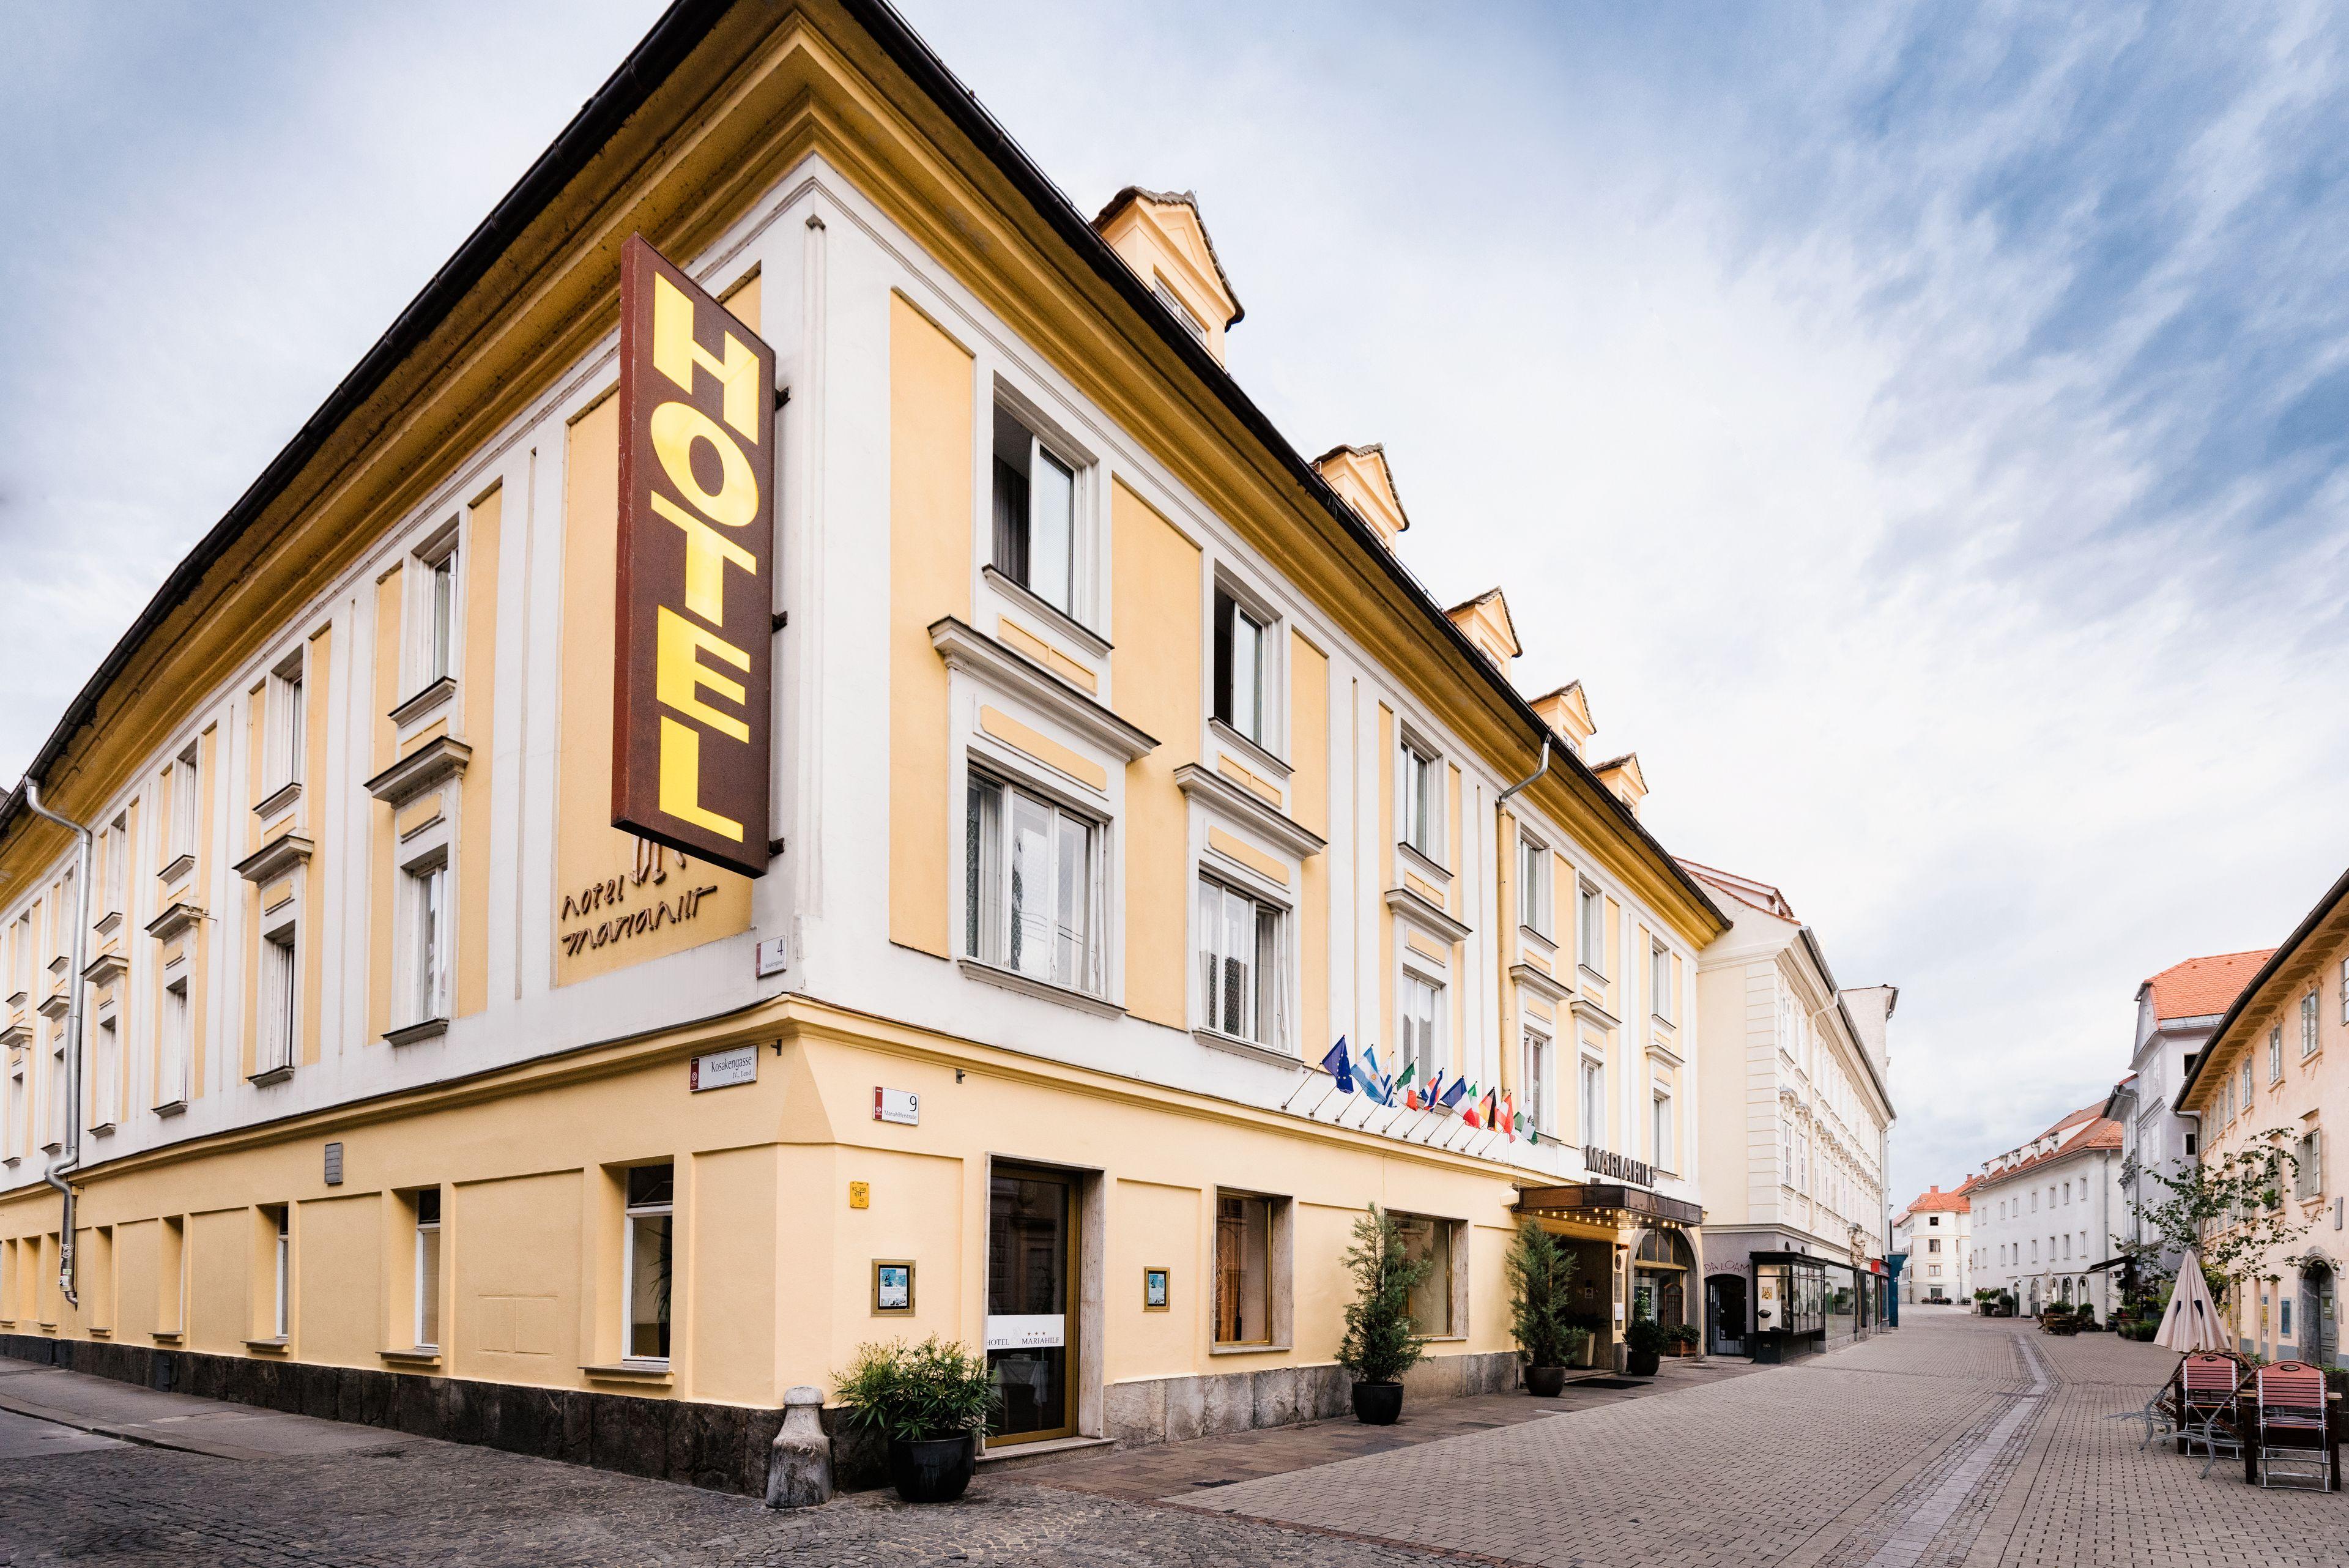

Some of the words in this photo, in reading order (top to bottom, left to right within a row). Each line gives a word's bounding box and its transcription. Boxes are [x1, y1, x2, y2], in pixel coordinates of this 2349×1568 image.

[651, 272, 759, 842] HOTEL
[777, 939, 783, 956] 4
[711, 1057, 752, 1072] Kosakengasse
[910, 1096, 917, 1112] 9
[1586, 1145, 1658, 1188] MARIAHILF
